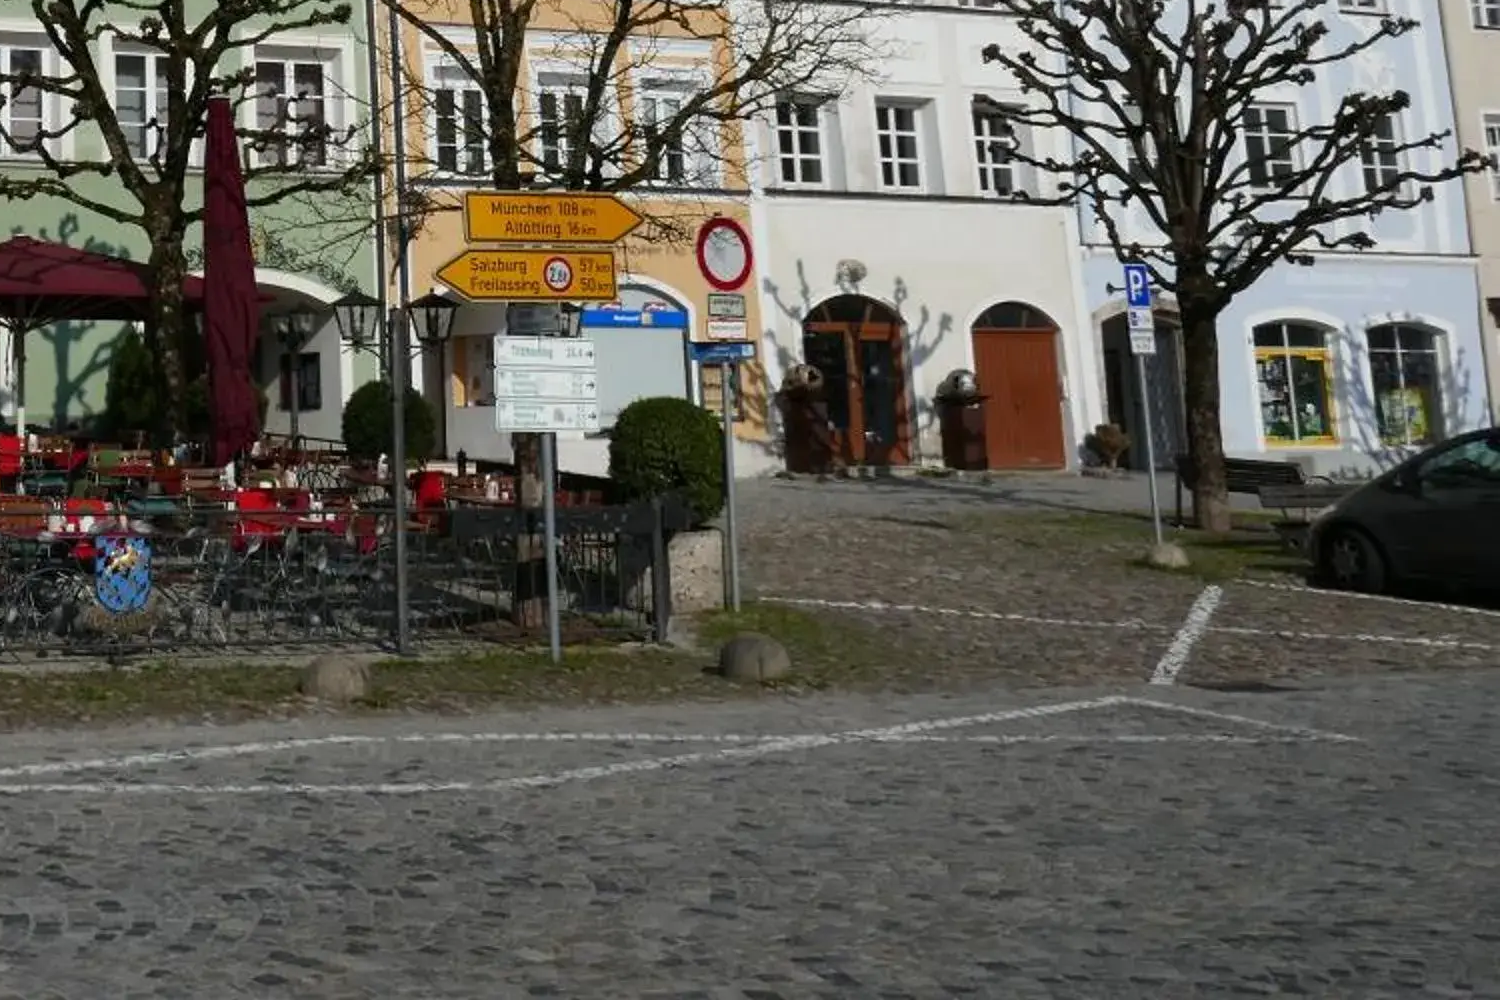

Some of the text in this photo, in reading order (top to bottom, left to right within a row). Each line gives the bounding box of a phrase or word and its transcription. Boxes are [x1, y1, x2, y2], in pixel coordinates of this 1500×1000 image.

[491, 202, 596, 215] München 108 km
[505, 221, 597, 238] Altötting 16 km
[470, 257, 611, 275] Salzburg 57 km
[470, 276, 612, 294] Freilassing 50 km
[1128, 269, 1143, 301] P
